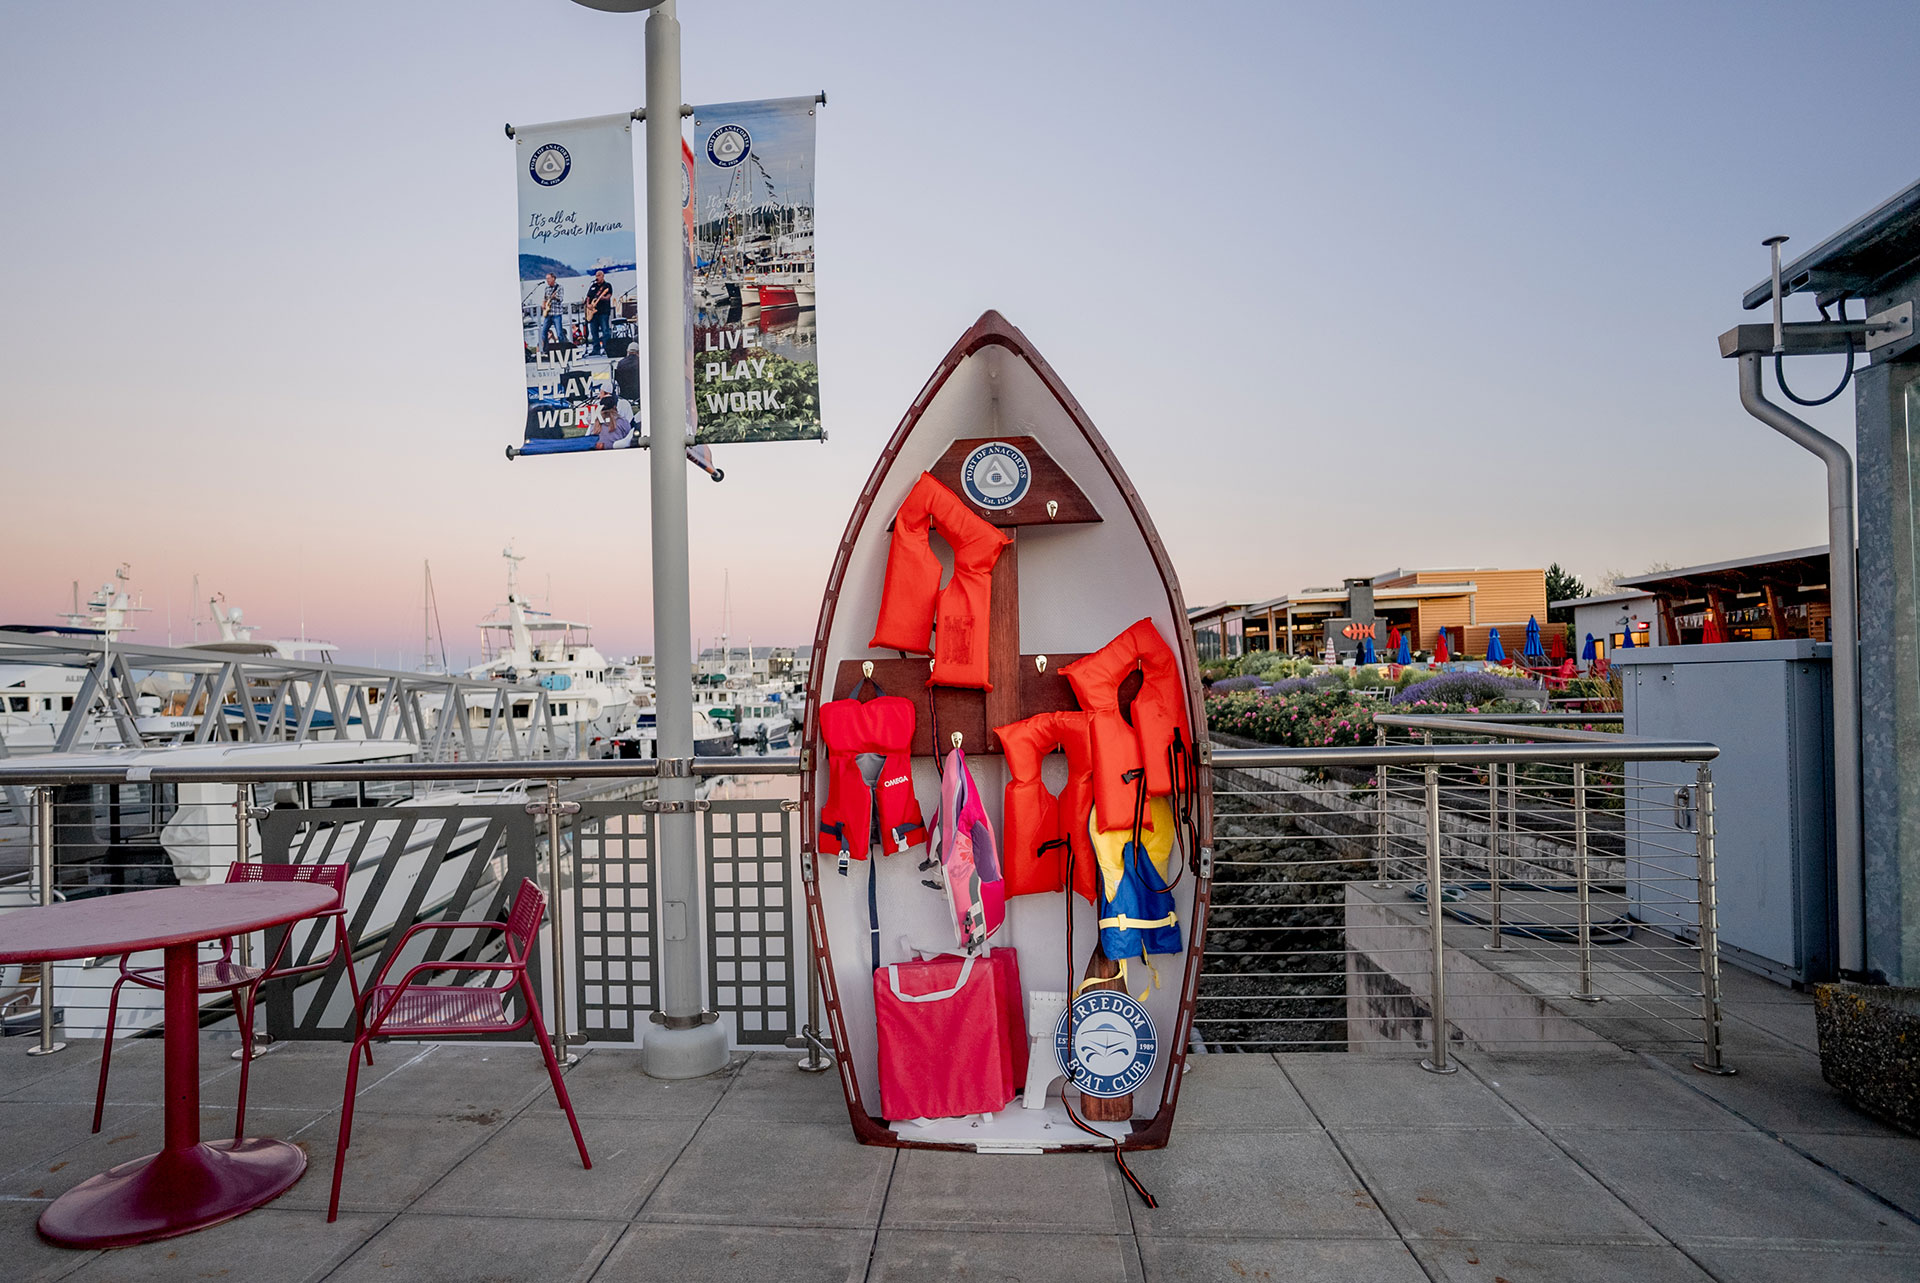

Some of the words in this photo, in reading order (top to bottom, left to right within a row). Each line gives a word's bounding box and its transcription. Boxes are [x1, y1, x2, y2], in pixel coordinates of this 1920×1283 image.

[529, 213, 546, 227] It's
[548, 210, 564, 224] all
[565, 211, 577, 223] at
[531, 226, 552, 243] Cap
[552, 224, 584, 238] Sante
[585, 221, 623, 235] Marina
[706, 328, 762, 352] LIVE.
[705, 358, 773, 382] PLAY.
[538, 375, 600, 400] PLAY.
[706, 389, 786, 414] WORK.
[537, 404, 611, 429] WORK.
[966, 459, 977, 482] PORT
[976, 450, 987, 460] OF
[988, 446, 1027, 479] ANACORTES
[983, 497, 996, 505] Est.
[997, 496, 1012, 505] 1926
[884, 775, 909, 788] OMEGA
[1139, 1043, 1155, 1051] 1989
[1067, 1058, 1104, 1091] BOAT
[1112, 1060, 1146, 1091] CLUB
